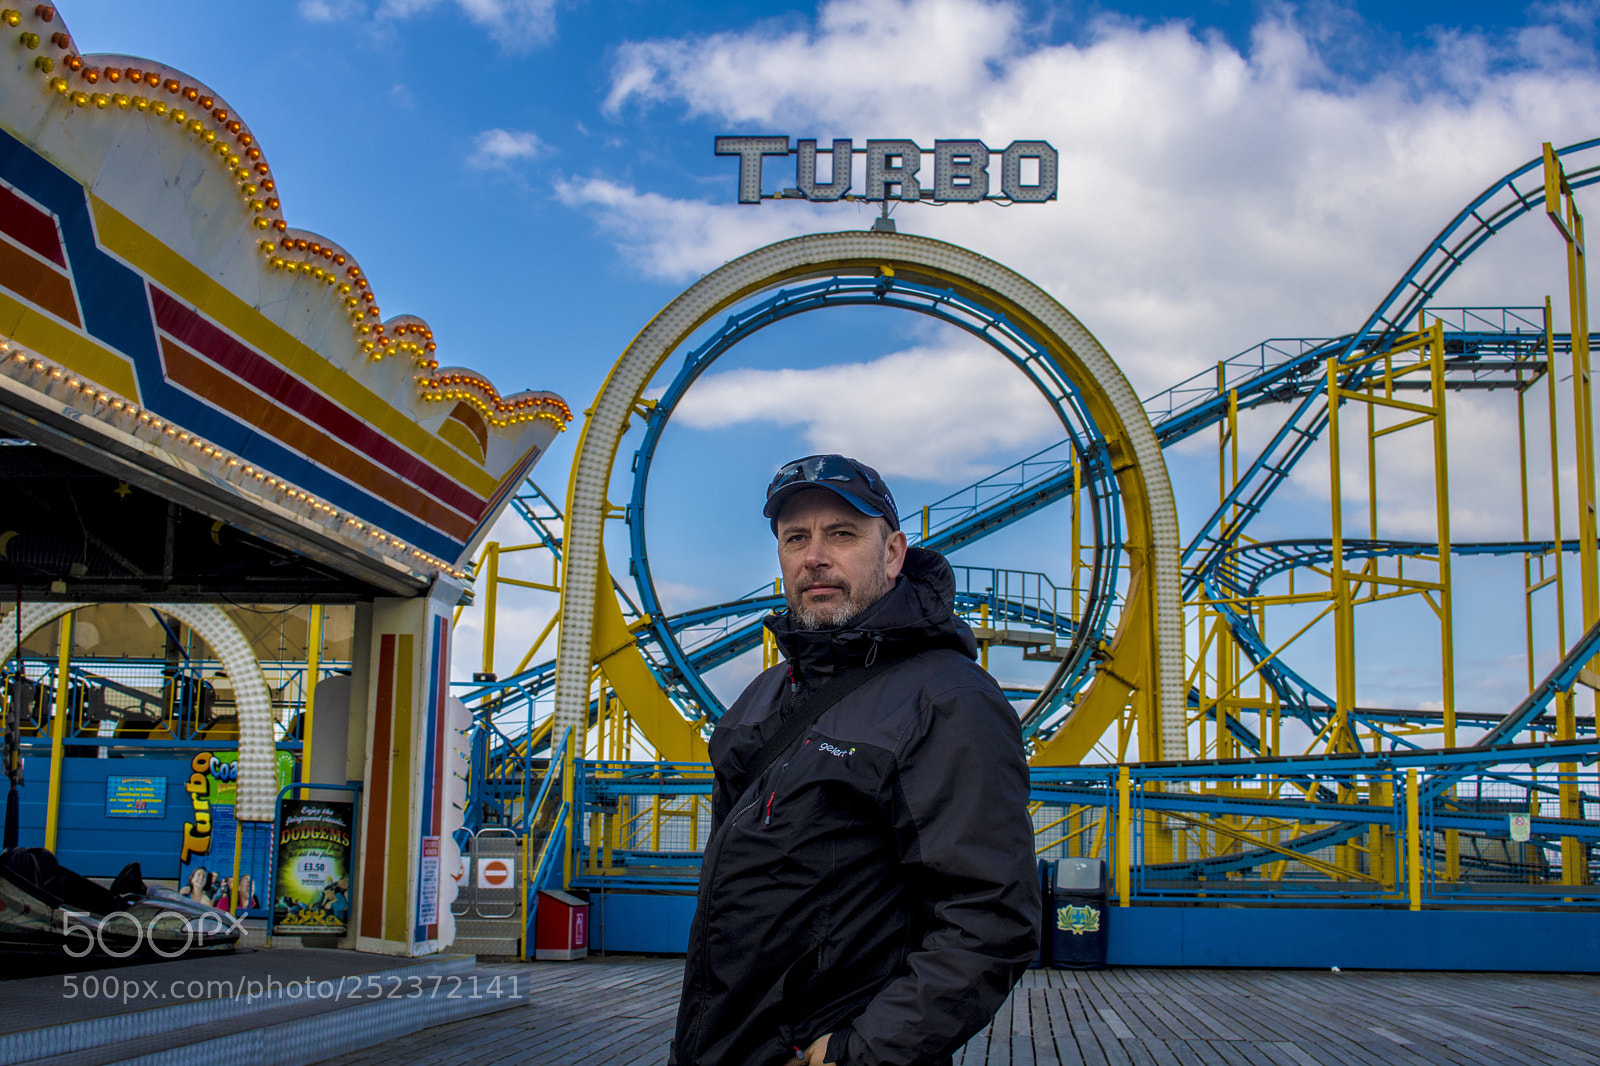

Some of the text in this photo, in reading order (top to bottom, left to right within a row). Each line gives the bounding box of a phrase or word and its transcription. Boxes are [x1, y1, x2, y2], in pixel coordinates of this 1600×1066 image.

[715, 135, 1058, 204] TURBO
[818, 742, 847, 757] gelert
[209, 756, 238, 781] Coa
[181, 751, 213, 864] Turbo
[301, 805, 334, 816] Enjoy the
[285, 815, 323, 827] fairground
[280, 826, 349, 846] DODGEMS
[304, 862, 326, 872] £3.50
